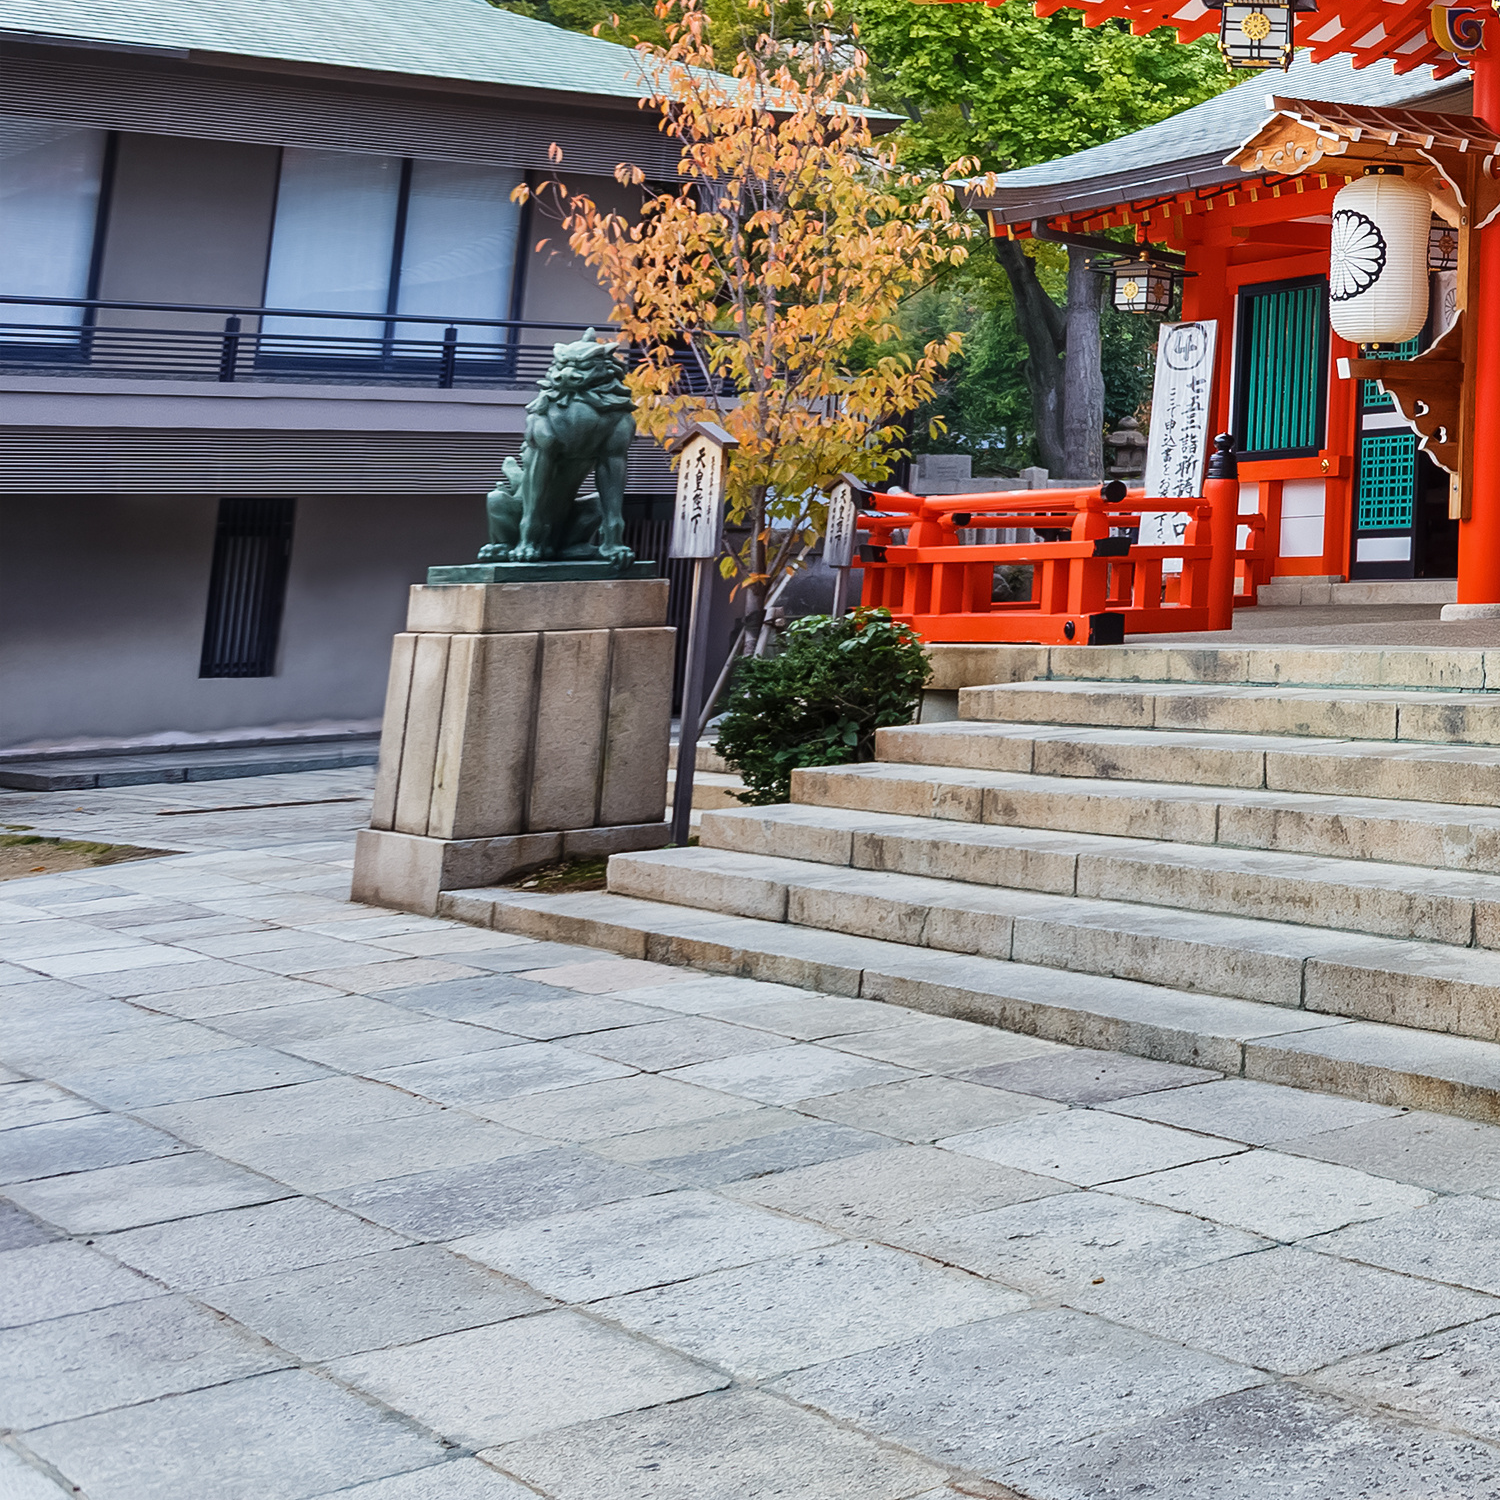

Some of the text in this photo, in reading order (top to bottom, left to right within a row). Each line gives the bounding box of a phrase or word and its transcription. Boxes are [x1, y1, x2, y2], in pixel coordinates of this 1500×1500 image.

[1172, 375, 1207, 538] 七五三詣祈祷口
